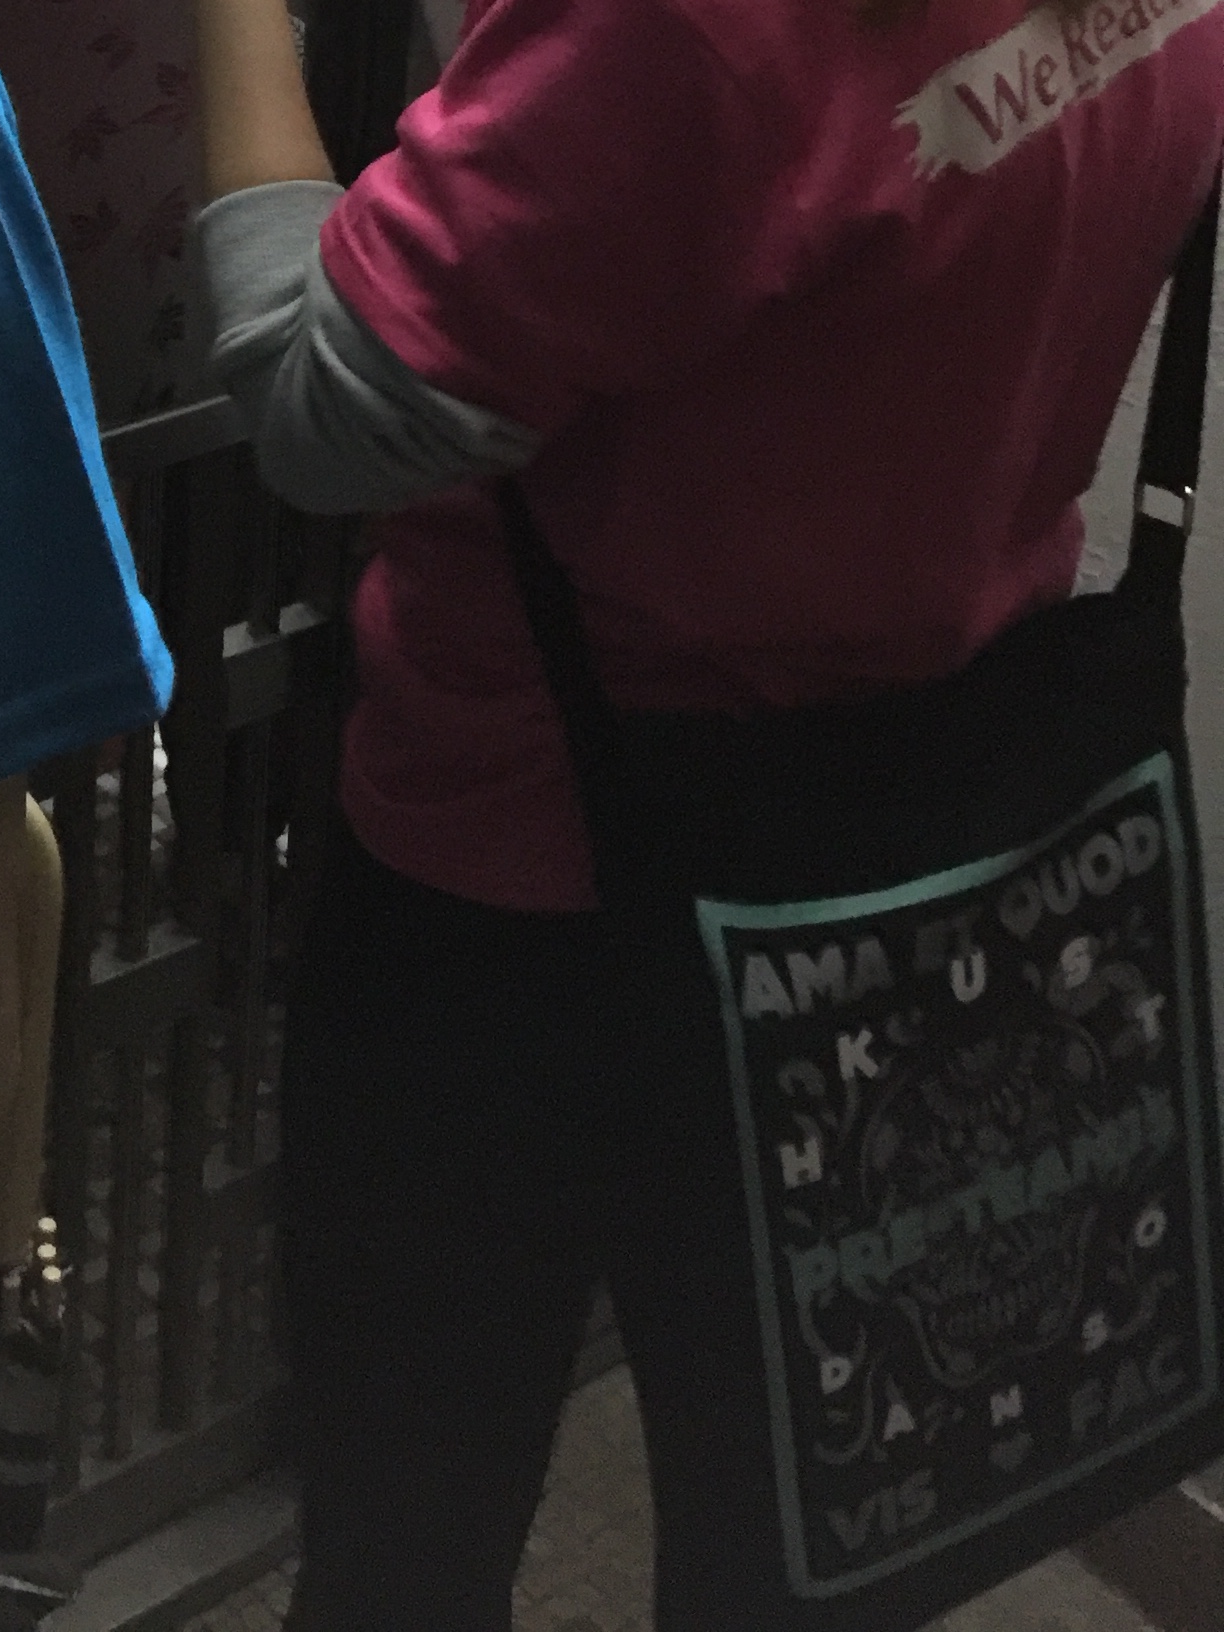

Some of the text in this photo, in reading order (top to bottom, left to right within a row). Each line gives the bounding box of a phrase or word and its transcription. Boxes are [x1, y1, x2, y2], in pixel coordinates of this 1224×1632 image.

[954, 48, 1057, 145] We
[741, 935, 895, 1021] AMA
[996, 814, 1162, 942] QUOD
[827, 1333, 1188, 1550] VIS FAC
